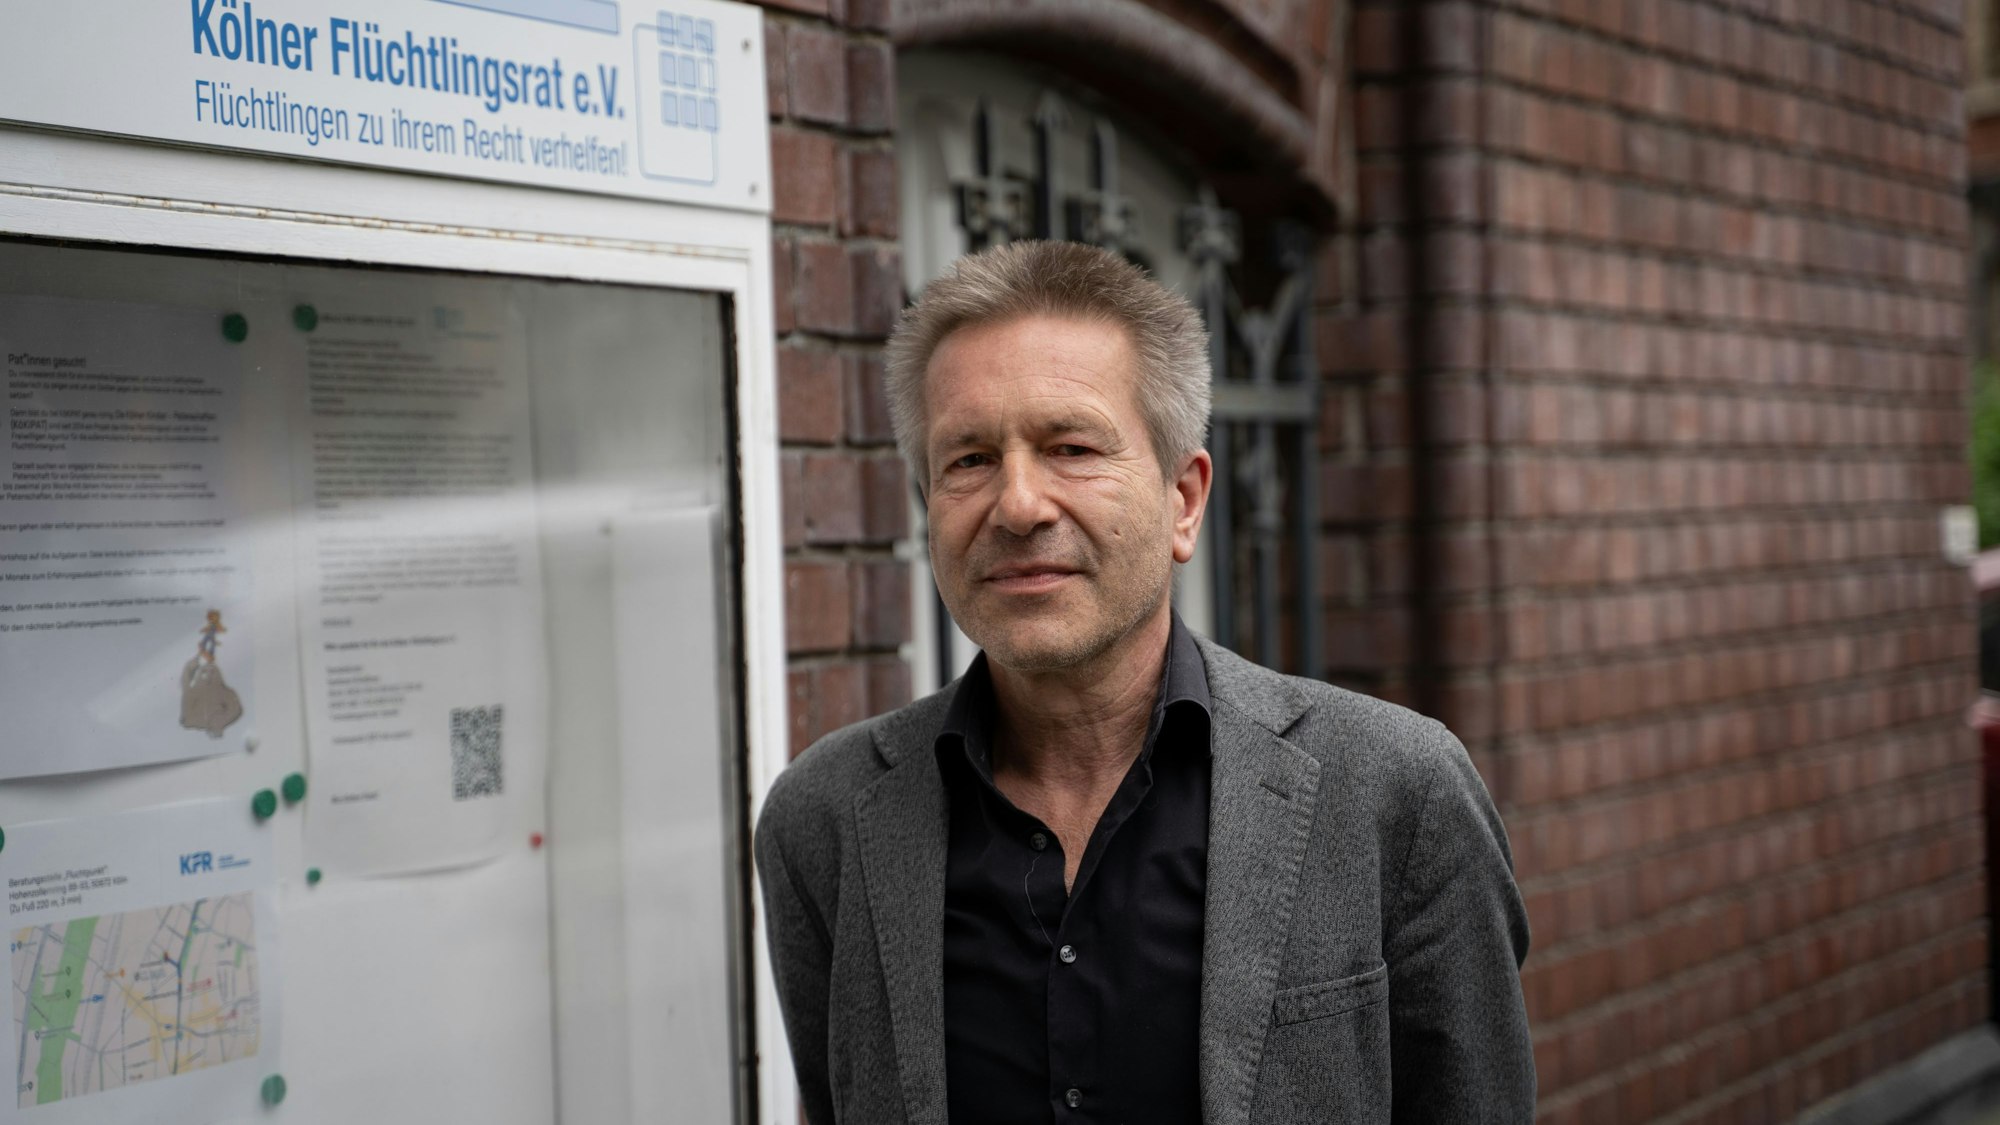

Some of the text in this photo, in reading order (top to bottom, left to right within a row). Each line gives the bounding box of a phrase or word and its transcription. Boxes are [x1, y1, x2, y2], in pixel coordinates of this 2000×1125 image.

[190, 0, 625, 120] Kölner Flüchtlingsrat e.V.
[195, 79, 628, 177] Flüchtlingen zu ihrem Recht verhelfen!
[180, 851, 212, 876] KFR
